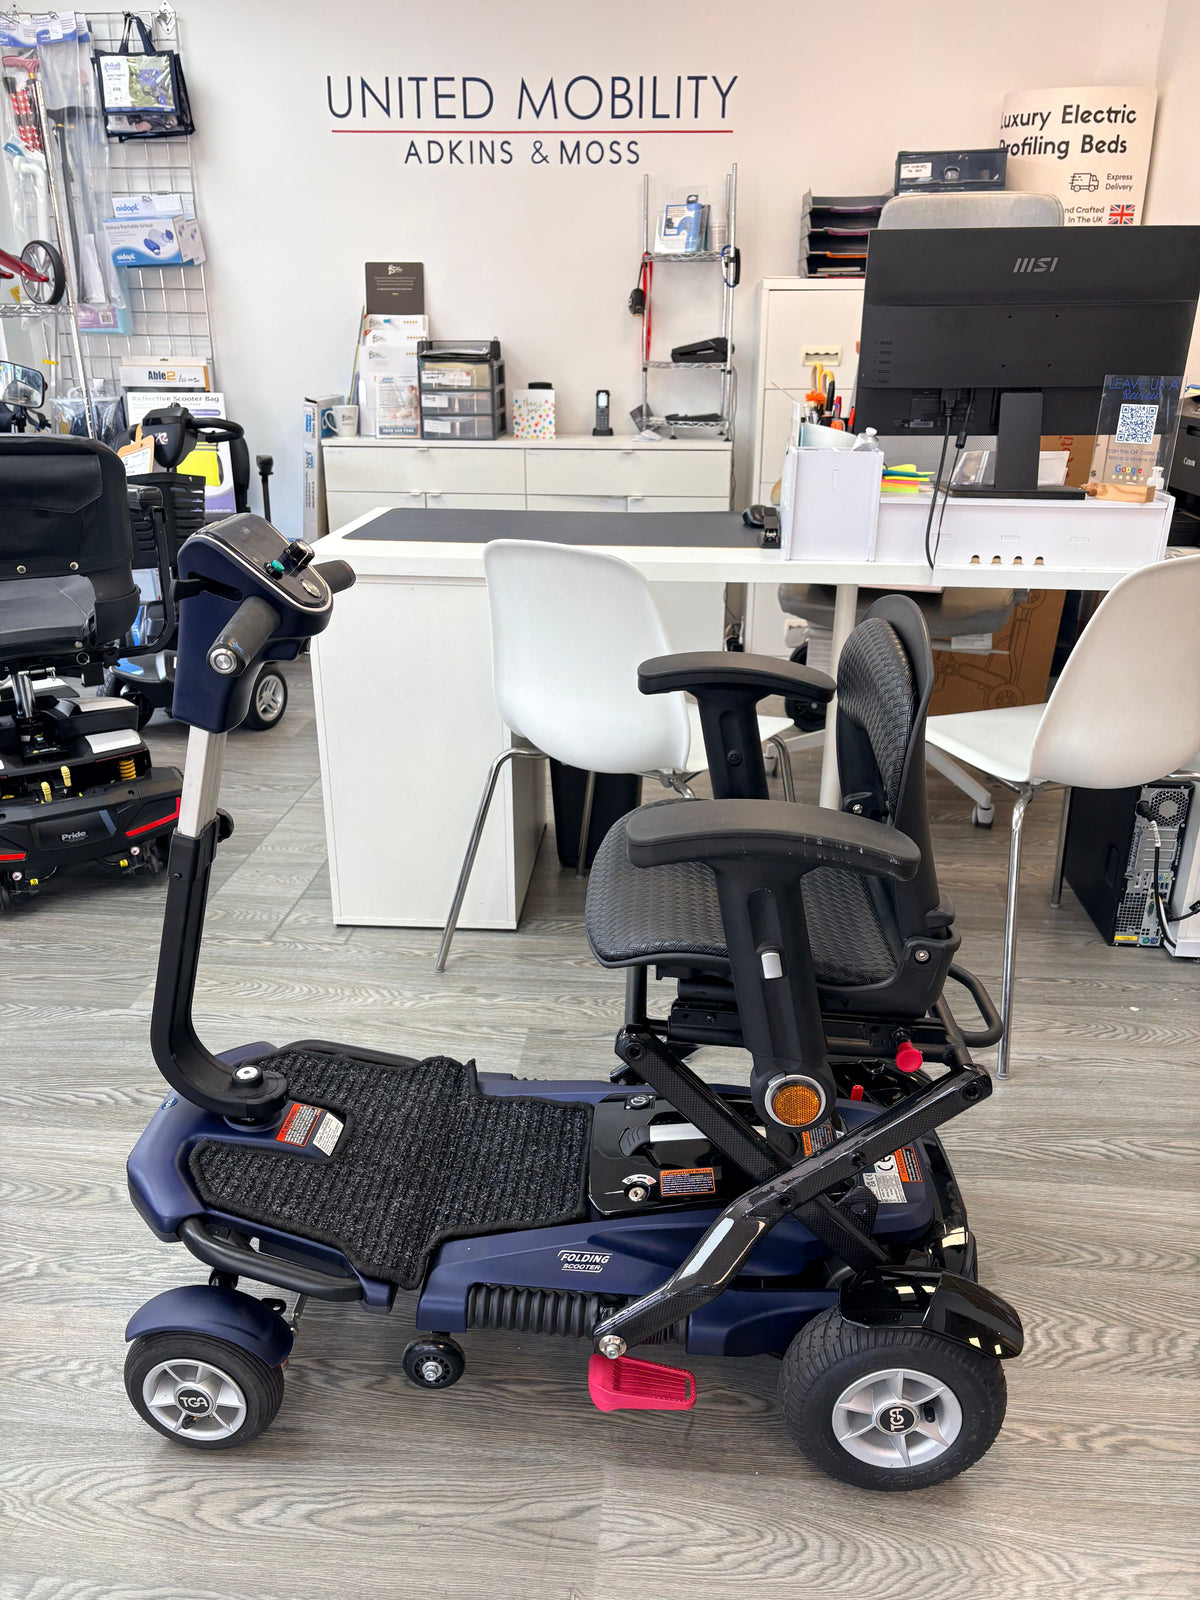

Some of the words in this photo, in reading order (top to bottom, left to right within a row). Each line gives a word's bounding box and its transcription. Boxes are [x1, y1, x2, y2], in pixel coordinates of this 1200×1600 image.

[326, 75, 494, 119] UNITED
[517, 75, 738, 120] MOBILITY
[1061, 103, 1137, 124] Electric
[1080, 133, 1128, 154] Beds
[404, 140, 514, 165] ADKINS
[530, 140, 550, 165] &
[559, 140, 641, 165] MOSS
[1106, 173, 1133, 182] Express
[1105, 182, 1133, 192] Delivery
[1064, 206, 1074, 214] nd
[1075, 206, 1105, 214] Crafted
[1012, 256, 1059, 273] MSI
[147, 370, 176, 381] Able2
[1108, 378, 1147, 391] LEAVE
[1150, 378, 1166, 391] US
[1169, 379, 1179, 391] A
[204, 395, 220, 403] Bag
[1122, 390, 1161, 400] Review
[1114, 464, 1143, 476] Google
[61, 830, 88, 842] Pride
[560, 1253, 611, 1264] FOLDING
[179, 1396, 209, 1408] TGA
[889, 1408, 905, 1432] TGA
